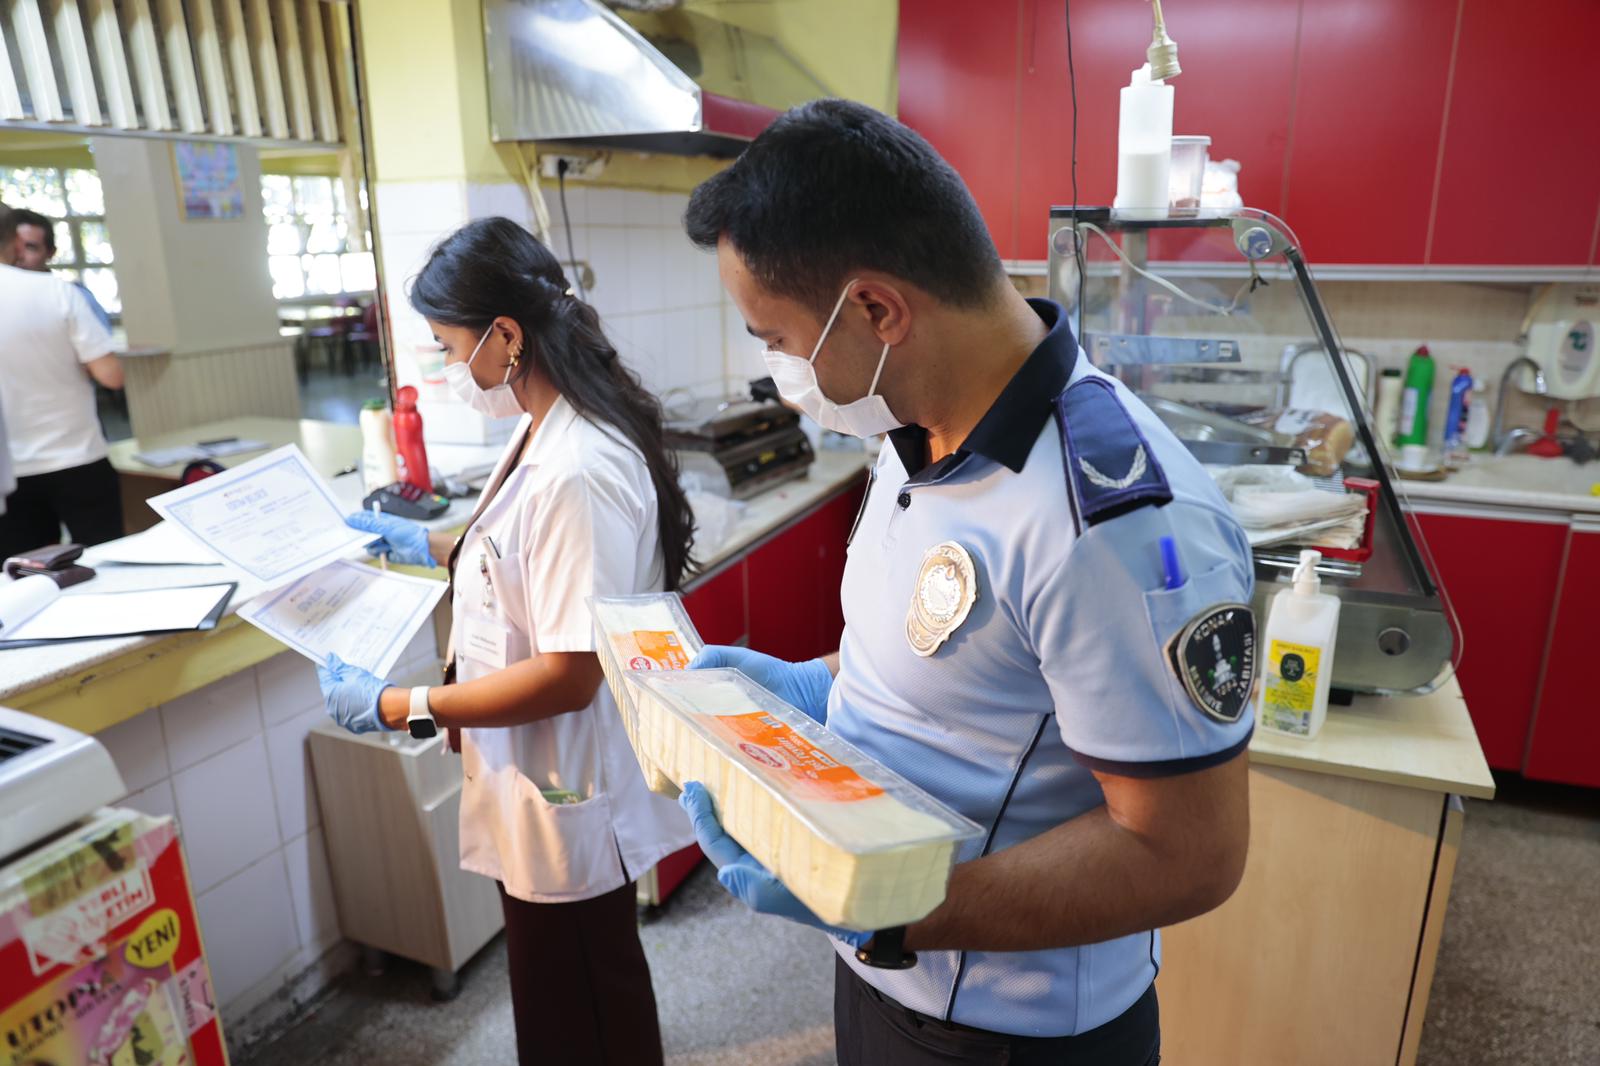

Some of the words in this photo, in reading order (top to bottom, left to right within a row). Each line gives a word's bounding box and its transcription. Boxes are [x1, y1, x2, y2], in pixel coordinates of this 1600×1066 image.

[1193, 611, 1234, 641] KONAK
[1236, 633, 1253, 699] ZABITASI
[130, 916, 177, 960] YENİ
